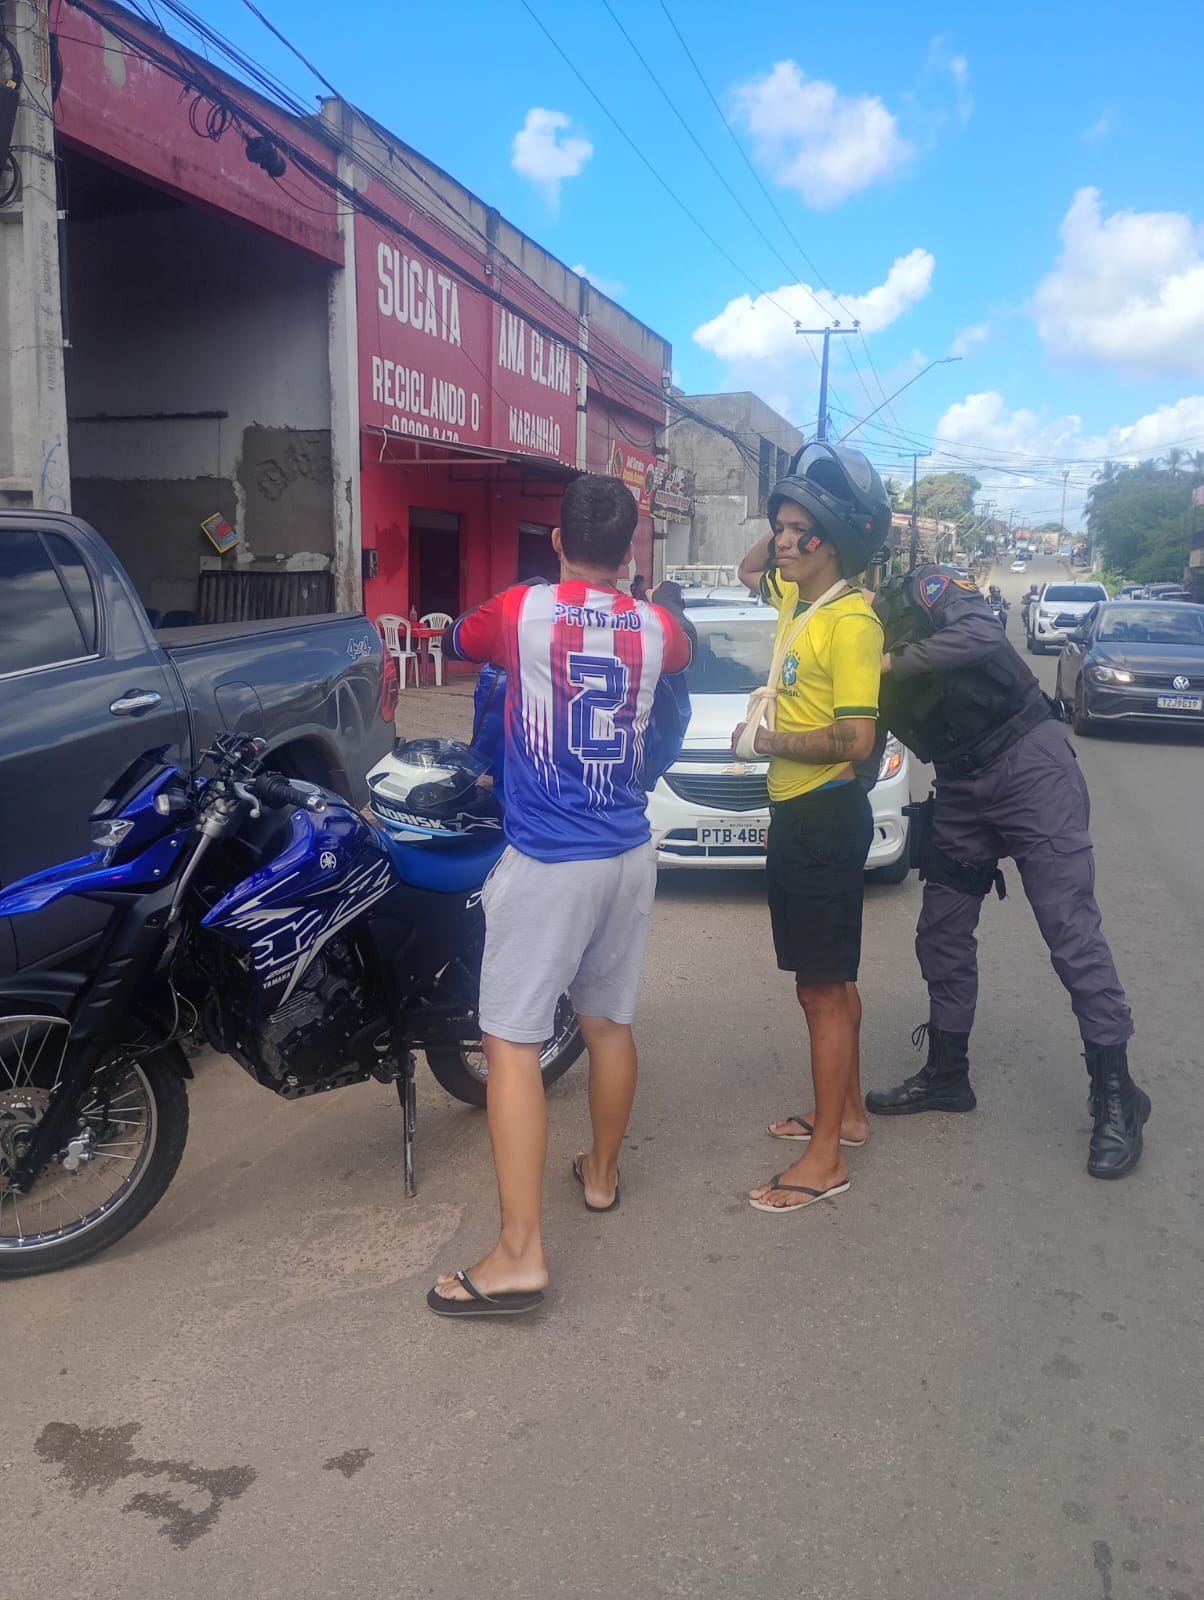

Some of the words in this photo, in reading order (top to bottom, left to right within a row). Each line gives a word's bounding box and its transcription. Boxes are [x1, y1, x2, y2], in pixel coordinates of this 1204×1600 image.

[377, 242, 462, 347] SUCATA
[498, 308, 526, 376] ANA
[530, 328, 572, 396] CLARA
[371, 355, 466, 428] RECICLANDO
[470, 392, 480, 432] O
[508, 405, 561, 457] MARANHÃO
[567, 652, 628, 764] 2
[375, 802, 448, 830] NORISK
[262, 971, 292, 990] YAMAHA
